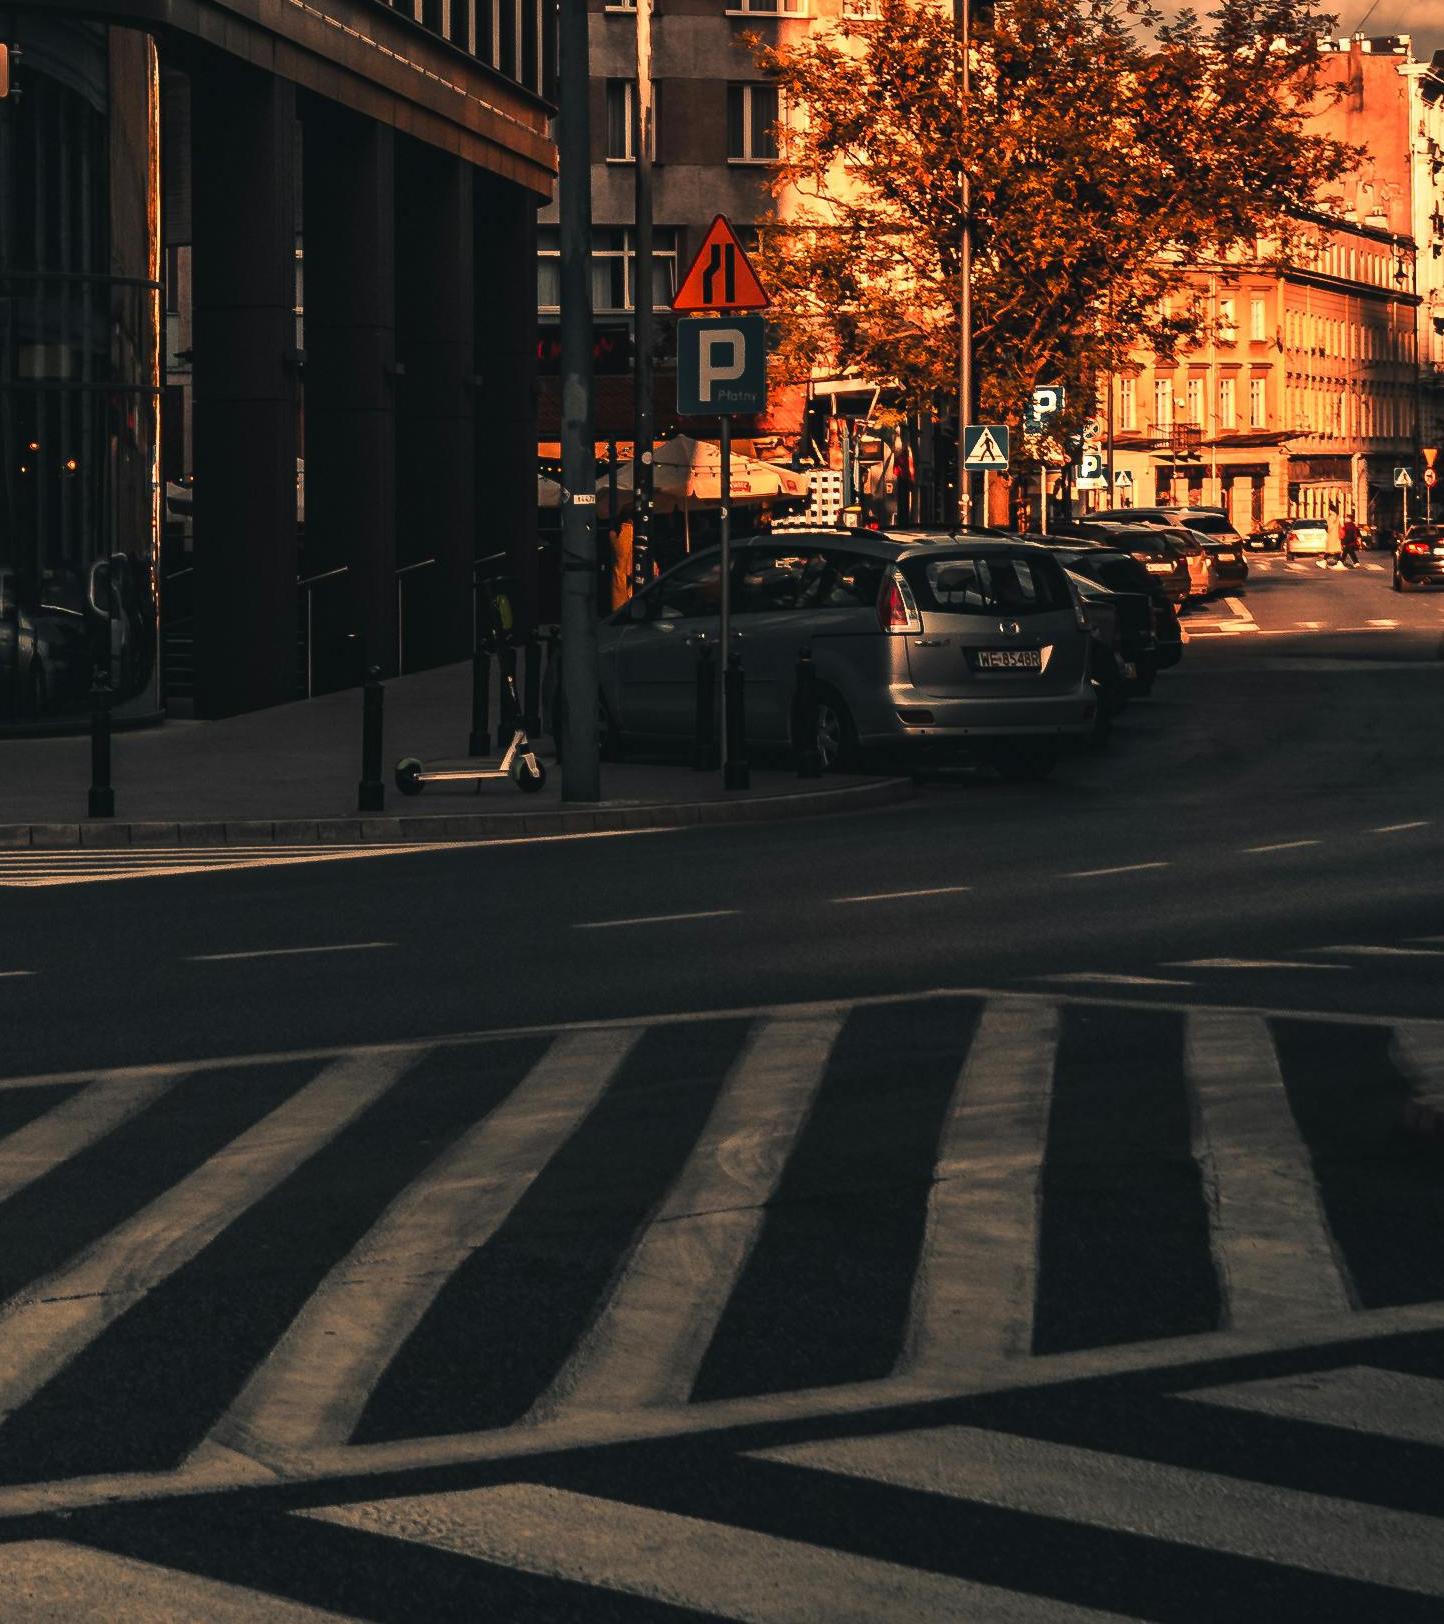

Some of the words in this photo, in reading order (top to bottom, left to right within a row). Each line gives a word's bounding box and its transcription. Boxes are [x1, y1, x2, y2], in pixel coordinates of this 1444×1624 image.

[699, 329, 745, 402] P
[718, 389, 758, 403] Płatny
[1033, 390, 1057, 421] P
[1082, 455, 1098, 478] P
